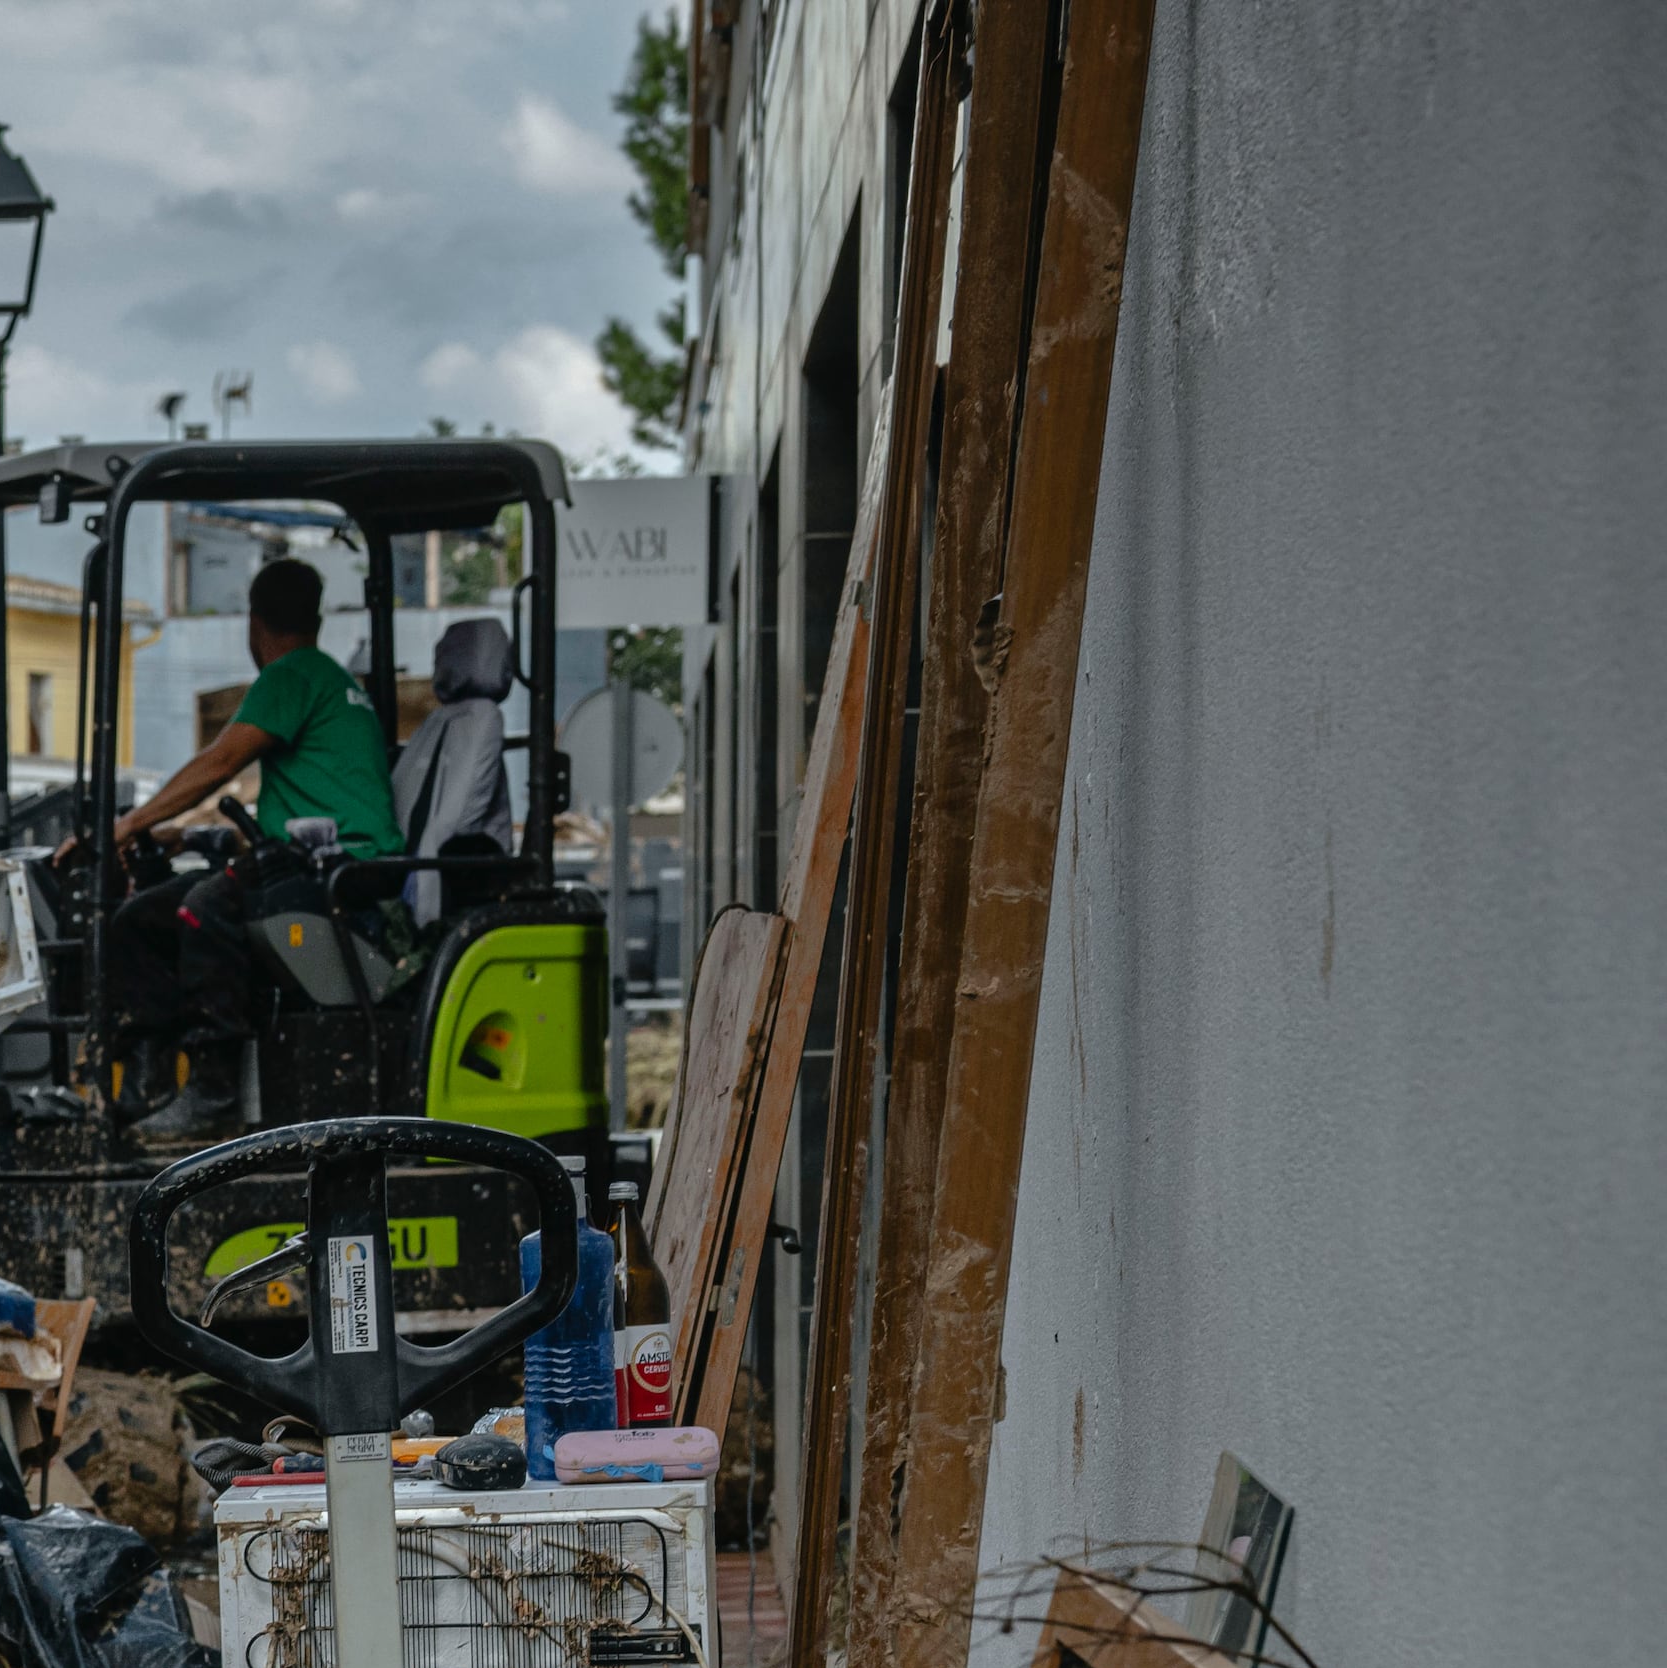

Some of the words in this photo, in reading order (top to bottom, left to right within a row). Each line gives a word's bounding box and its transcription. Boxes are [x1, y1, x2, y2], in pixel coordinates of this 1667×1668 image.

[566, 527, 667, 561] WABI
[353, 1264, 368, 1311] TECNICS
[355, 1313, 369, 1347] CARPI
[639, 1350, 669, 1363] AMSTE
